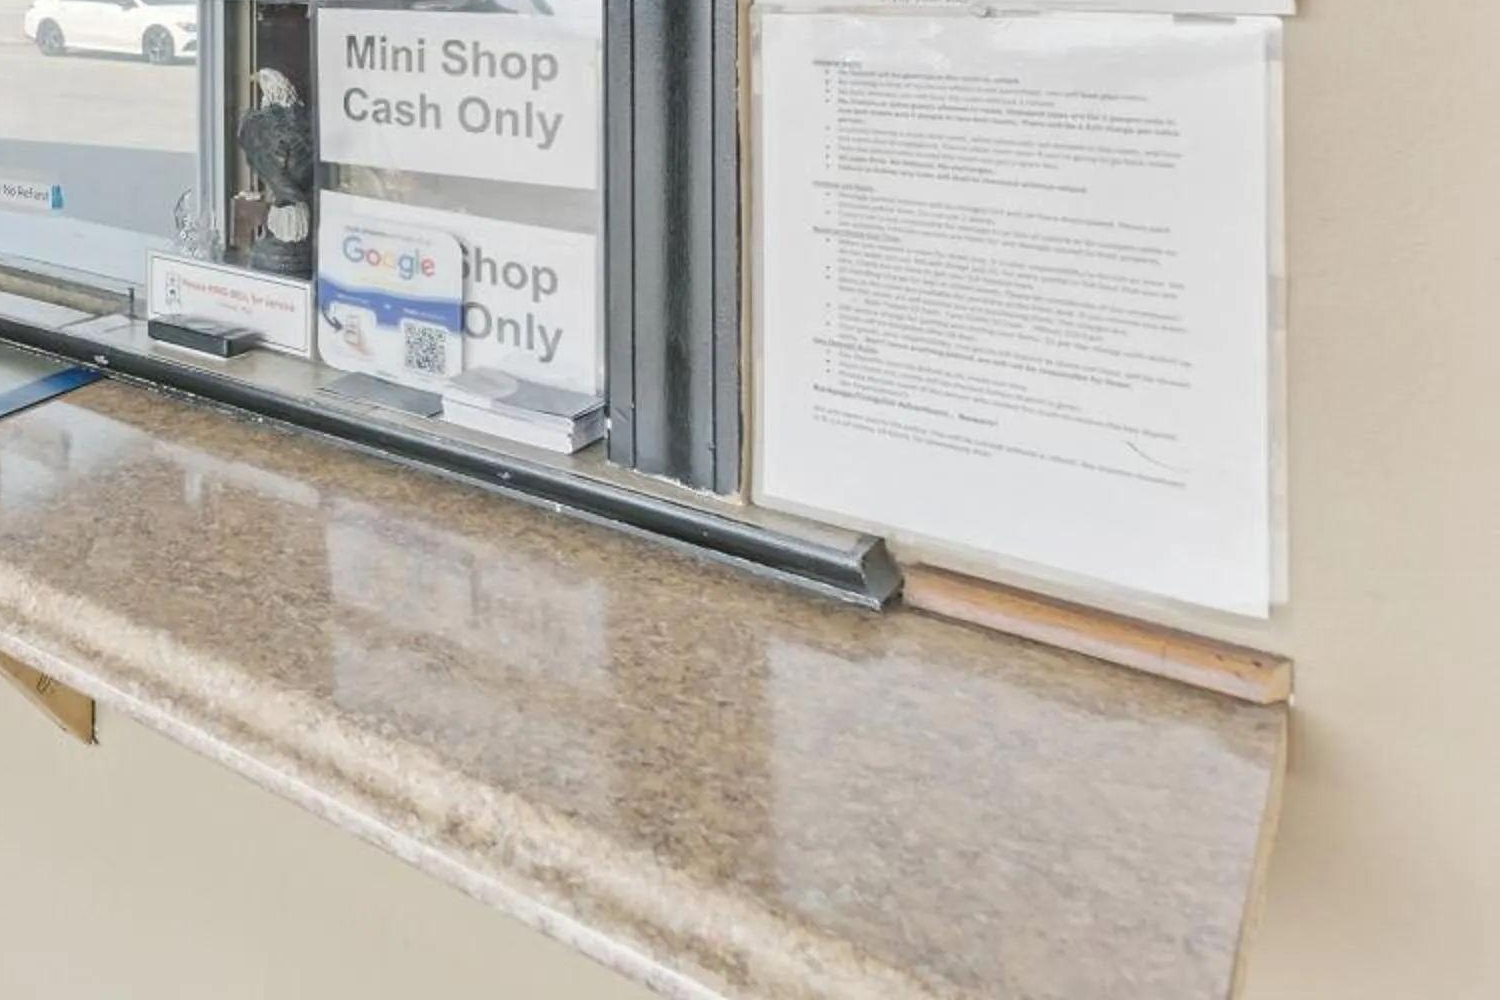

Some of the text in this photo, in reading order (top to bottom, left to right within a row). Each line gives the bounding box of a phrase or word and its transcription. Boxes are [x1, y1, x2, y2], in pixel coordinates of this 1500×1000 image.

[346, 34, 559, 91] Mini Shop
[343, 87, 564, 151] Cash Only
[343, 235, 436, 281] Google
[464, 301, 564, 363] Only
